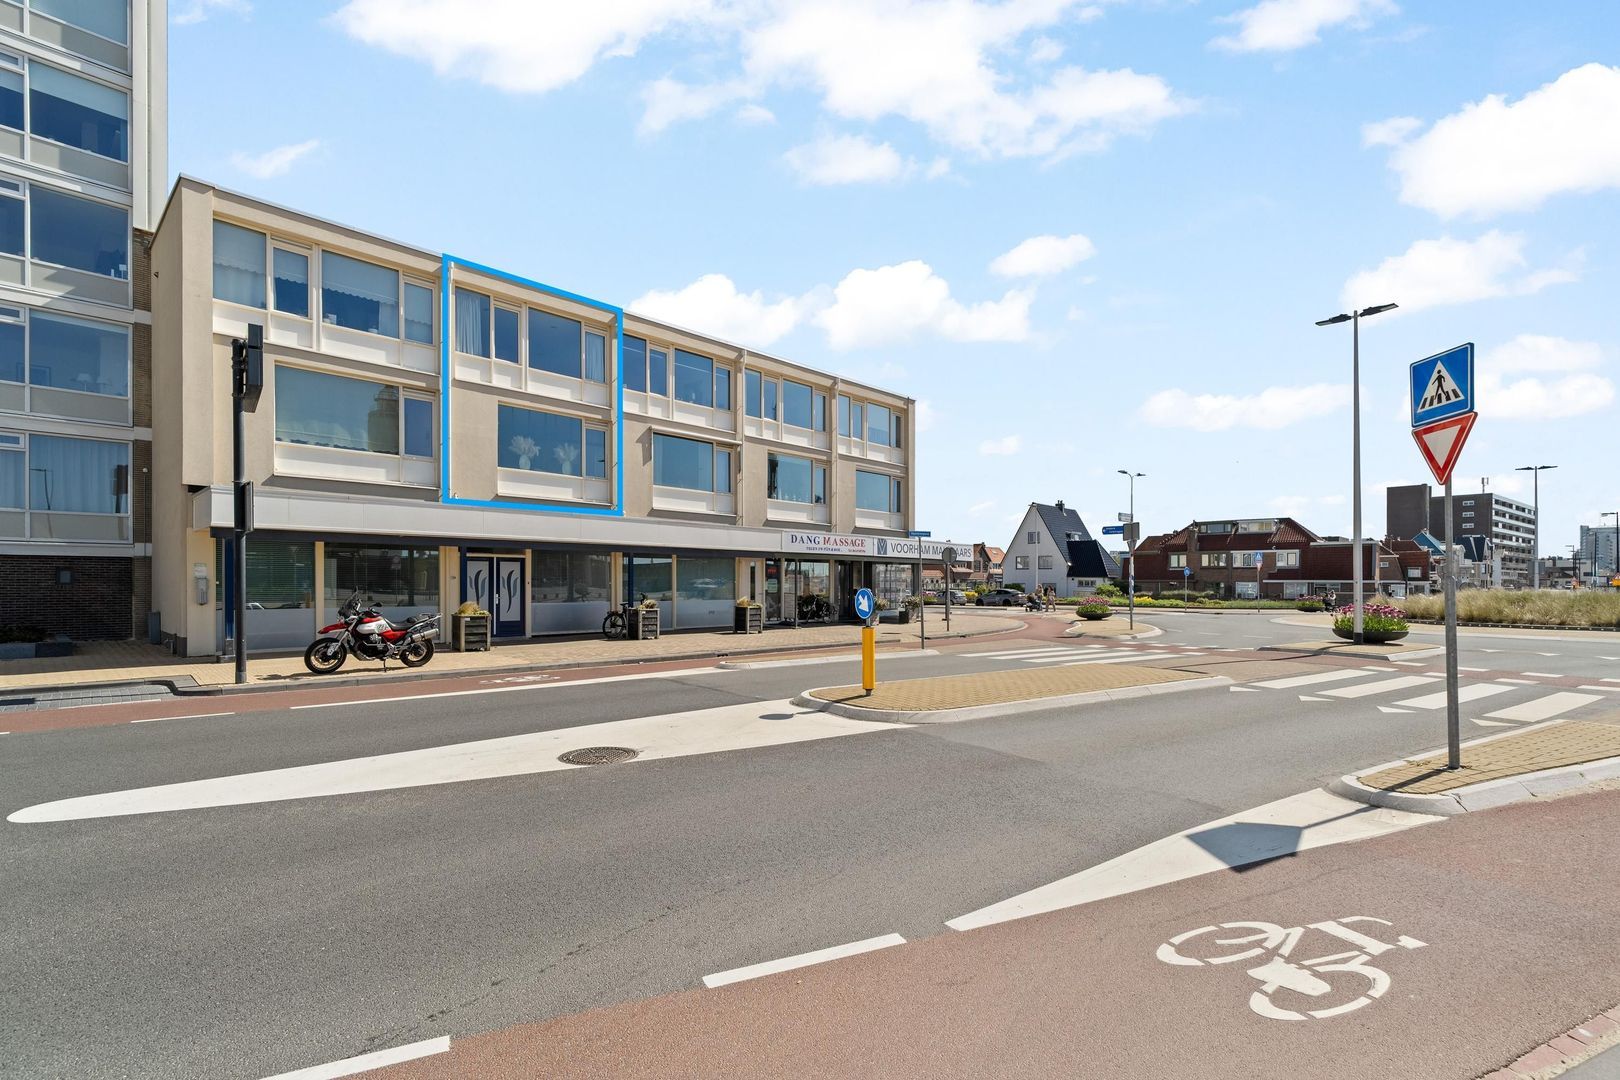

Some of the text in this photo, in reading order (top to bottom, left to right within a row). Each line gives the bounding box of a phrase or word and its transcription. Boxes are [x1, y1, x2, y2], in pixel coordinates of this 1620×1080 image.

[791, 534, 866, 548] DANG MASSAGE
[890, 542, 930, 556] VOORHAM
